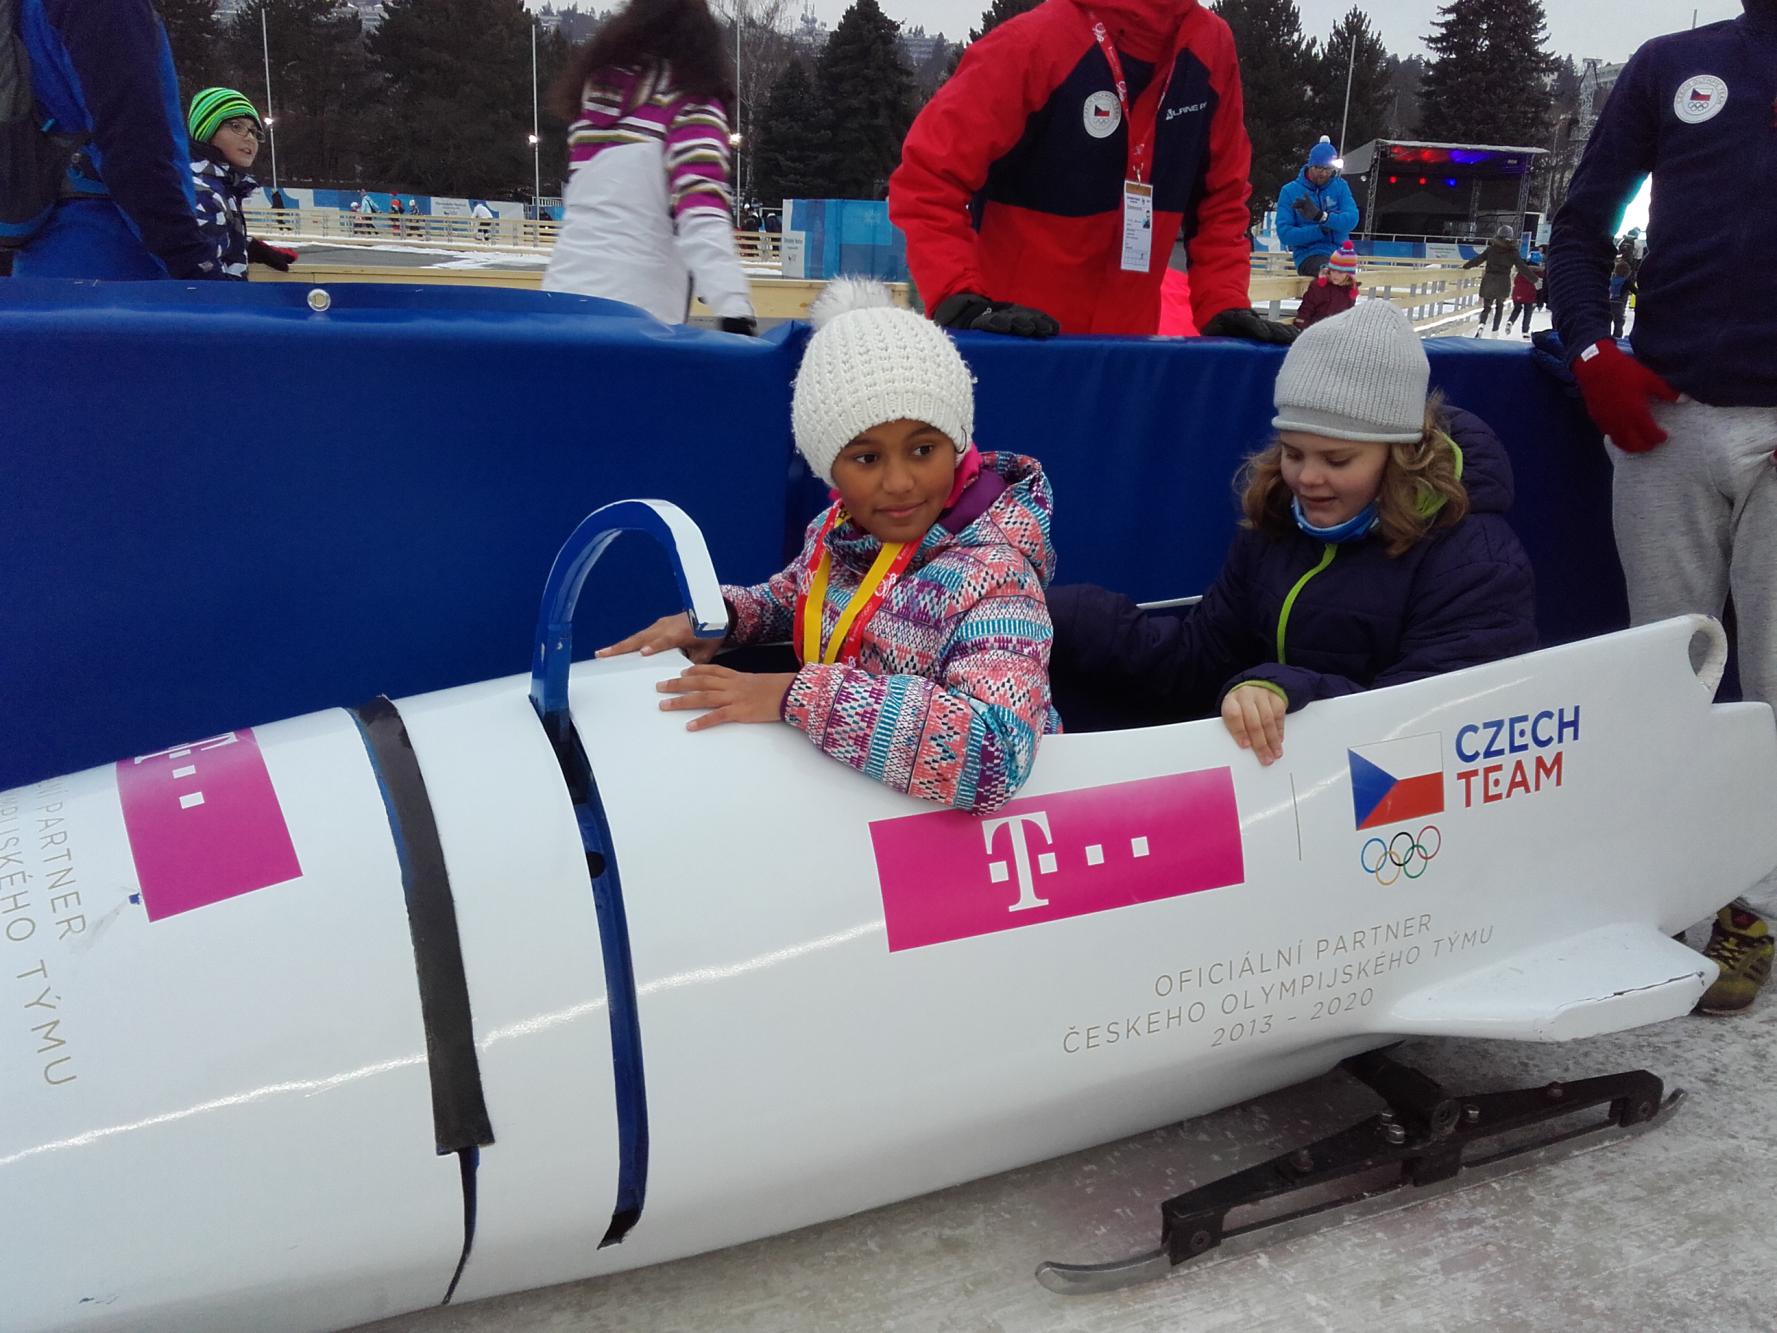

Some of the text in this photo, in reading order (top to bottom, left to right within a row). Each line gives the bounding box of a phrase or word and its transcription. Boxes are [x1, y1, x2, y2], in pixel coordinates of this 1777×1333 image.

[1455, 705, 1580, 763] CZECH
[1456, 751, 1563, 808] TEAM
[37, 801, 87, 941] PARTNER
[1154, 913, 1432, 997] OFICIÁLNÍ PARTNER
[1221, 945, 1421, 1015] OLYMPIJSKÉHO
[1432, 925, 1494, 957] TÝMU
[16, 959, 77, 1086] TÝMU
[1211, 1013, 1274, 1048] 2013
[1310, 988, 1374, 1022] 2020
